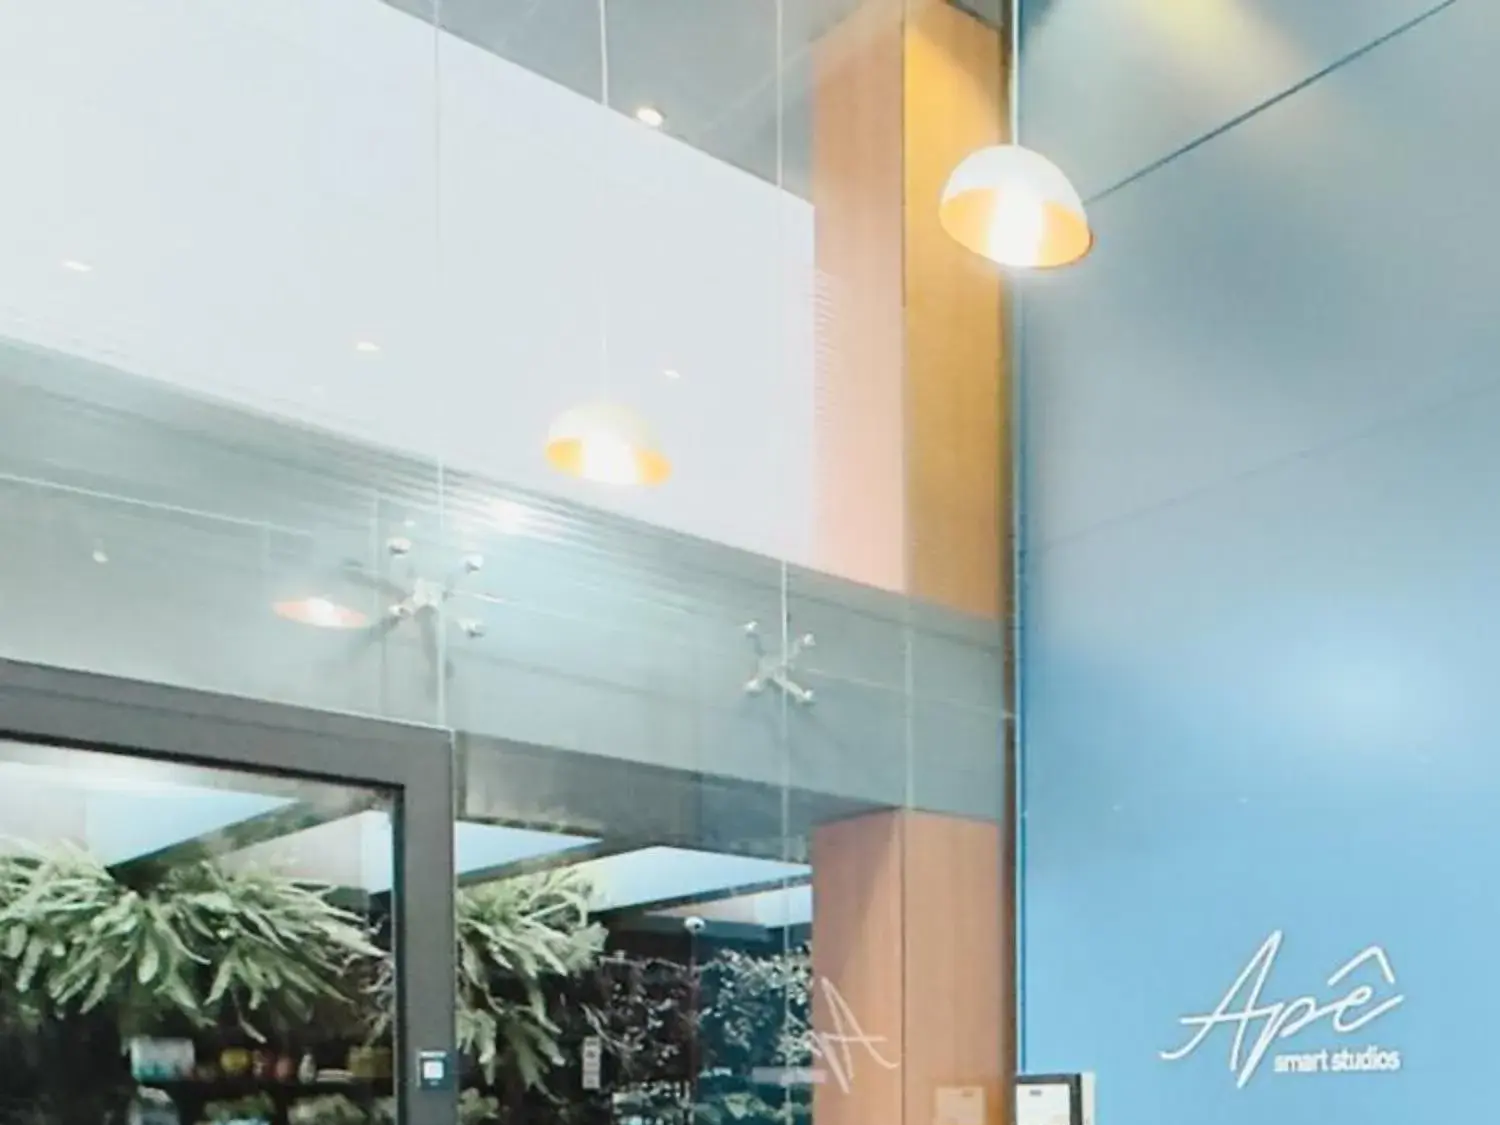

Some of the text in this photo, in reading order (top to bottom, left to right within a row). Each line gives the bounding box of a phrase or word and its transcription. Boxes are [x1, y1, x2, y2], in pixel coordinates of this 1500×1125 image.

[1159, 929, 1404, 1088] Apê
[1274, 1045, 1401, 1073] smart studios
